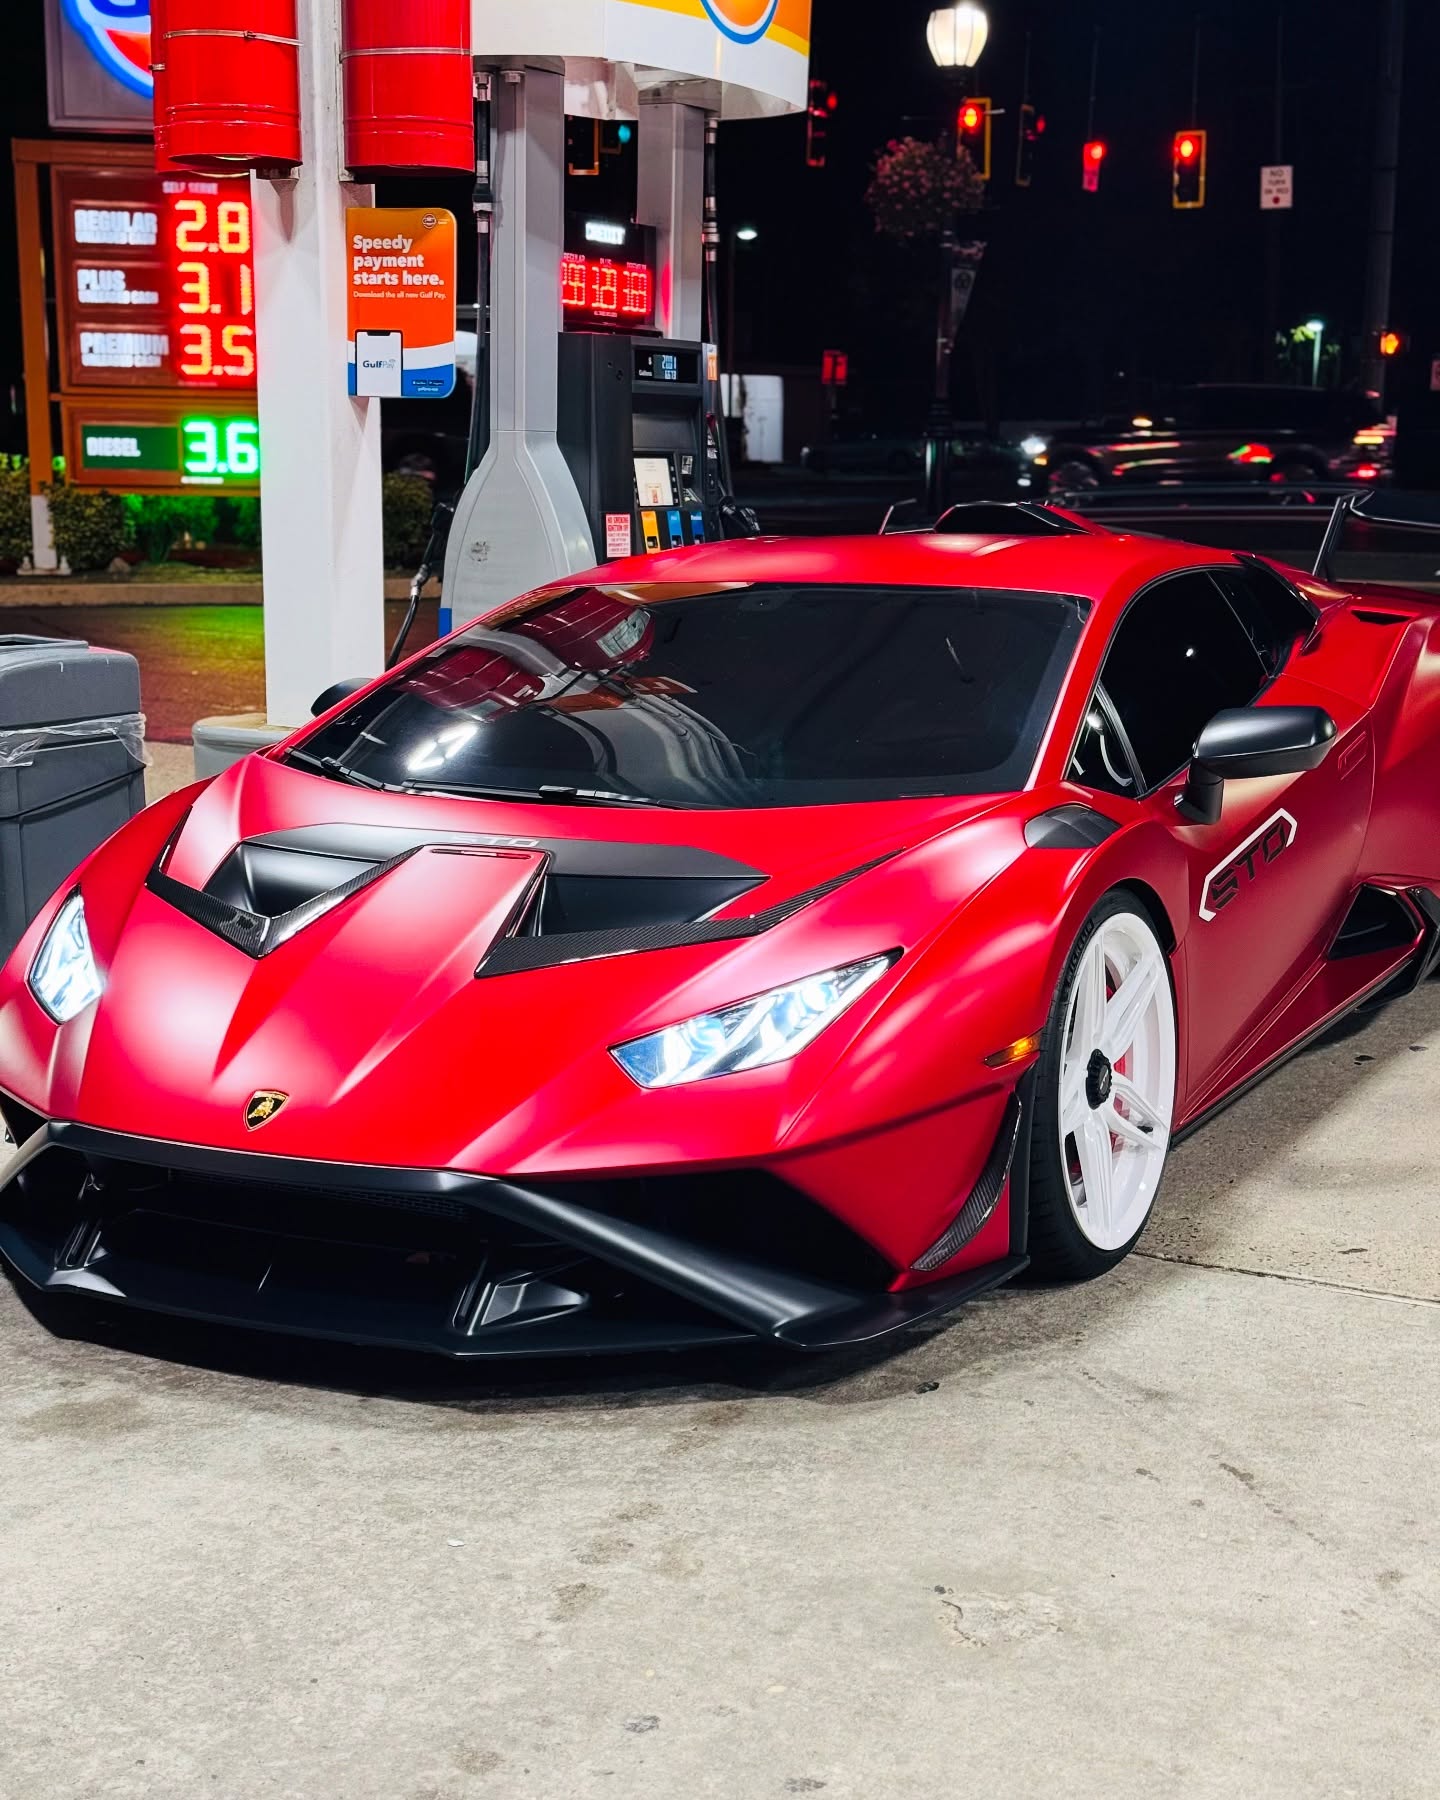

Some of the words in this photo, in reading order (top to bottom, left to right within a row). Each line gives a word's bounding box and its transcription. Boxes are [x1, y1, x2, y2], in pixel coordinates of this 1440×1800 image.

[75, 209, 157, 233] REGULAR
[353, 235, 413, 253] Speedy
[354, 254, 424, 271] payment
[77, 269, 126, 290] PLUS
[353, 271, 399, 285] starts
[402, 270, 444, 285] here.
[353, 290, 385, 298] Download
[419, 291, 433, 299] Gulf
[433, 292, 447, 300] Pay.
[80, 332, 169, 355] PREMIUM
[86, 437, 141, 457] DIESEL
[1210, 822, 1287, 911] STO
